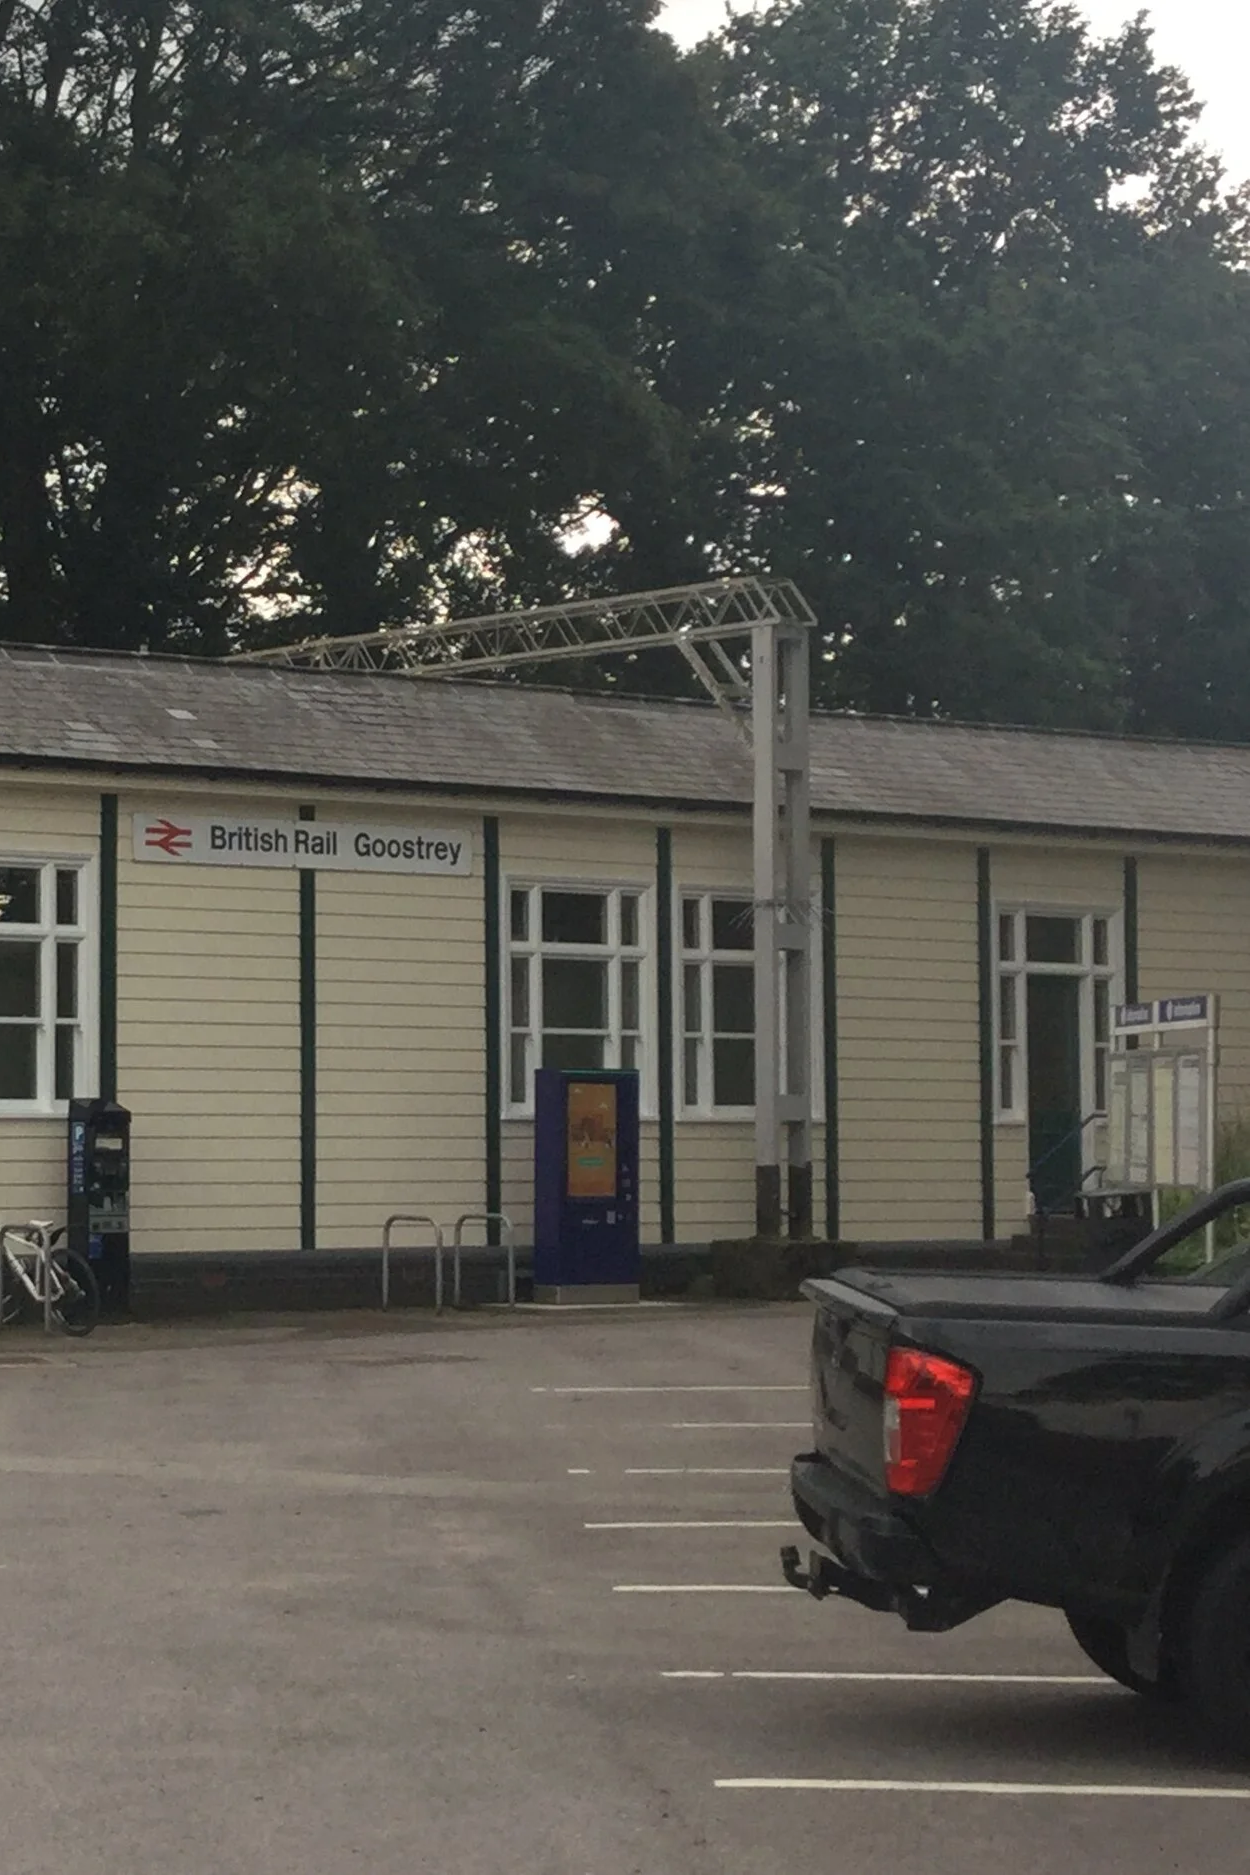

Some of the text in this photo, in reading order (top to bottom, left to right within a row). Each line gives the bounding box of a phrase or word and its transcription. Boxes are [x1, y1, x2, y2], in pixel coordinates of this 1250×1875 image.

[210, 825, 462, 865] British Rail Goostrey
